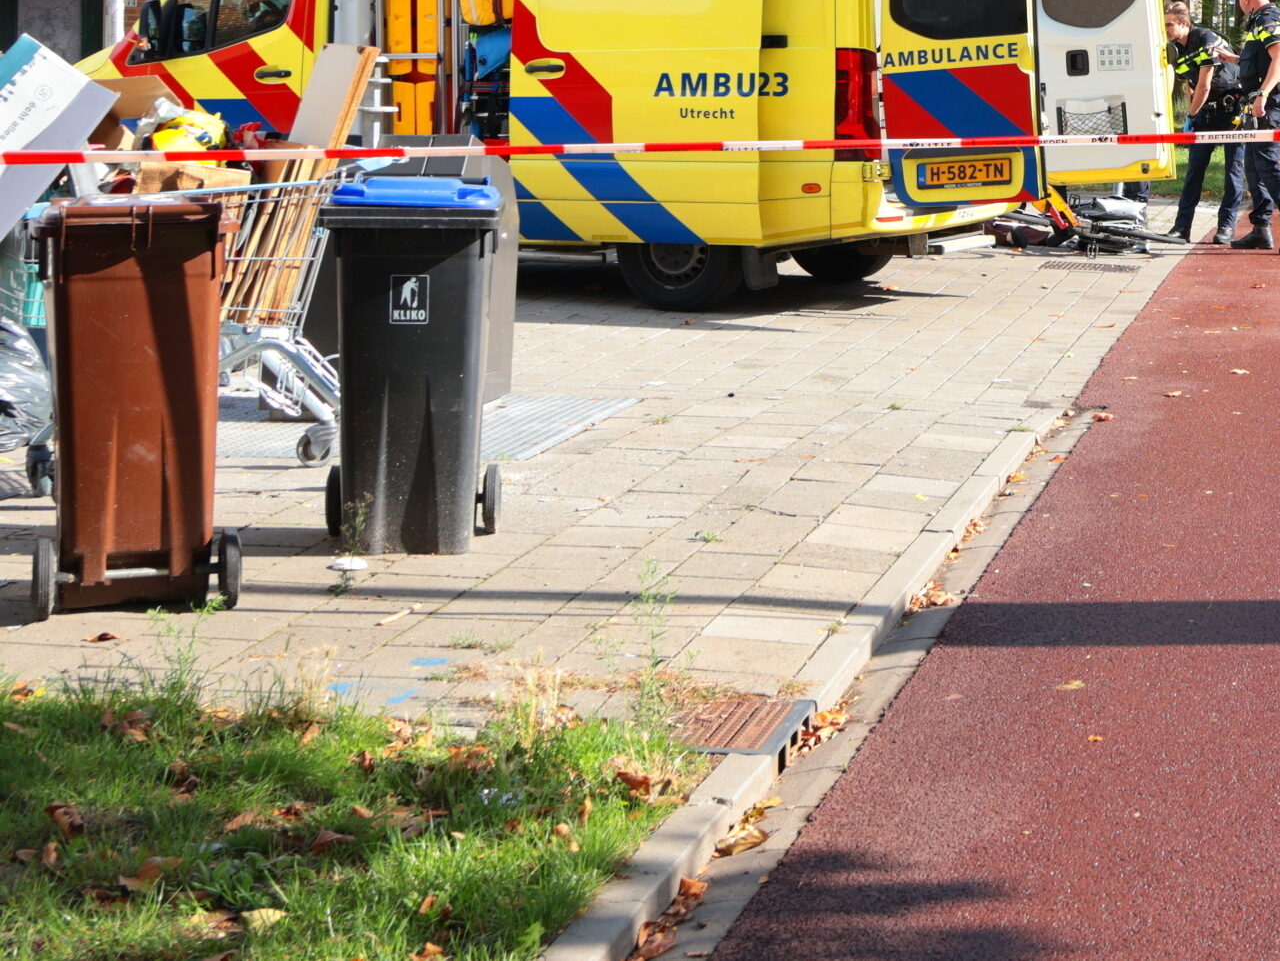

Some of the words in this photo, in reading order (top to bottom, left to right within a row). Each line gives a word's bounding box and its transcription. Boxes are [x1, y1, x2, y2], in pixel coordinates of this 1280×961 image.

[883, 42, 1019, 68] AMBULANCE
[679, 107, 735, 119] Utrecht
[930, 162, 1004, 182] H-582-TN
[393, 309, 426, 320] KLIKO
